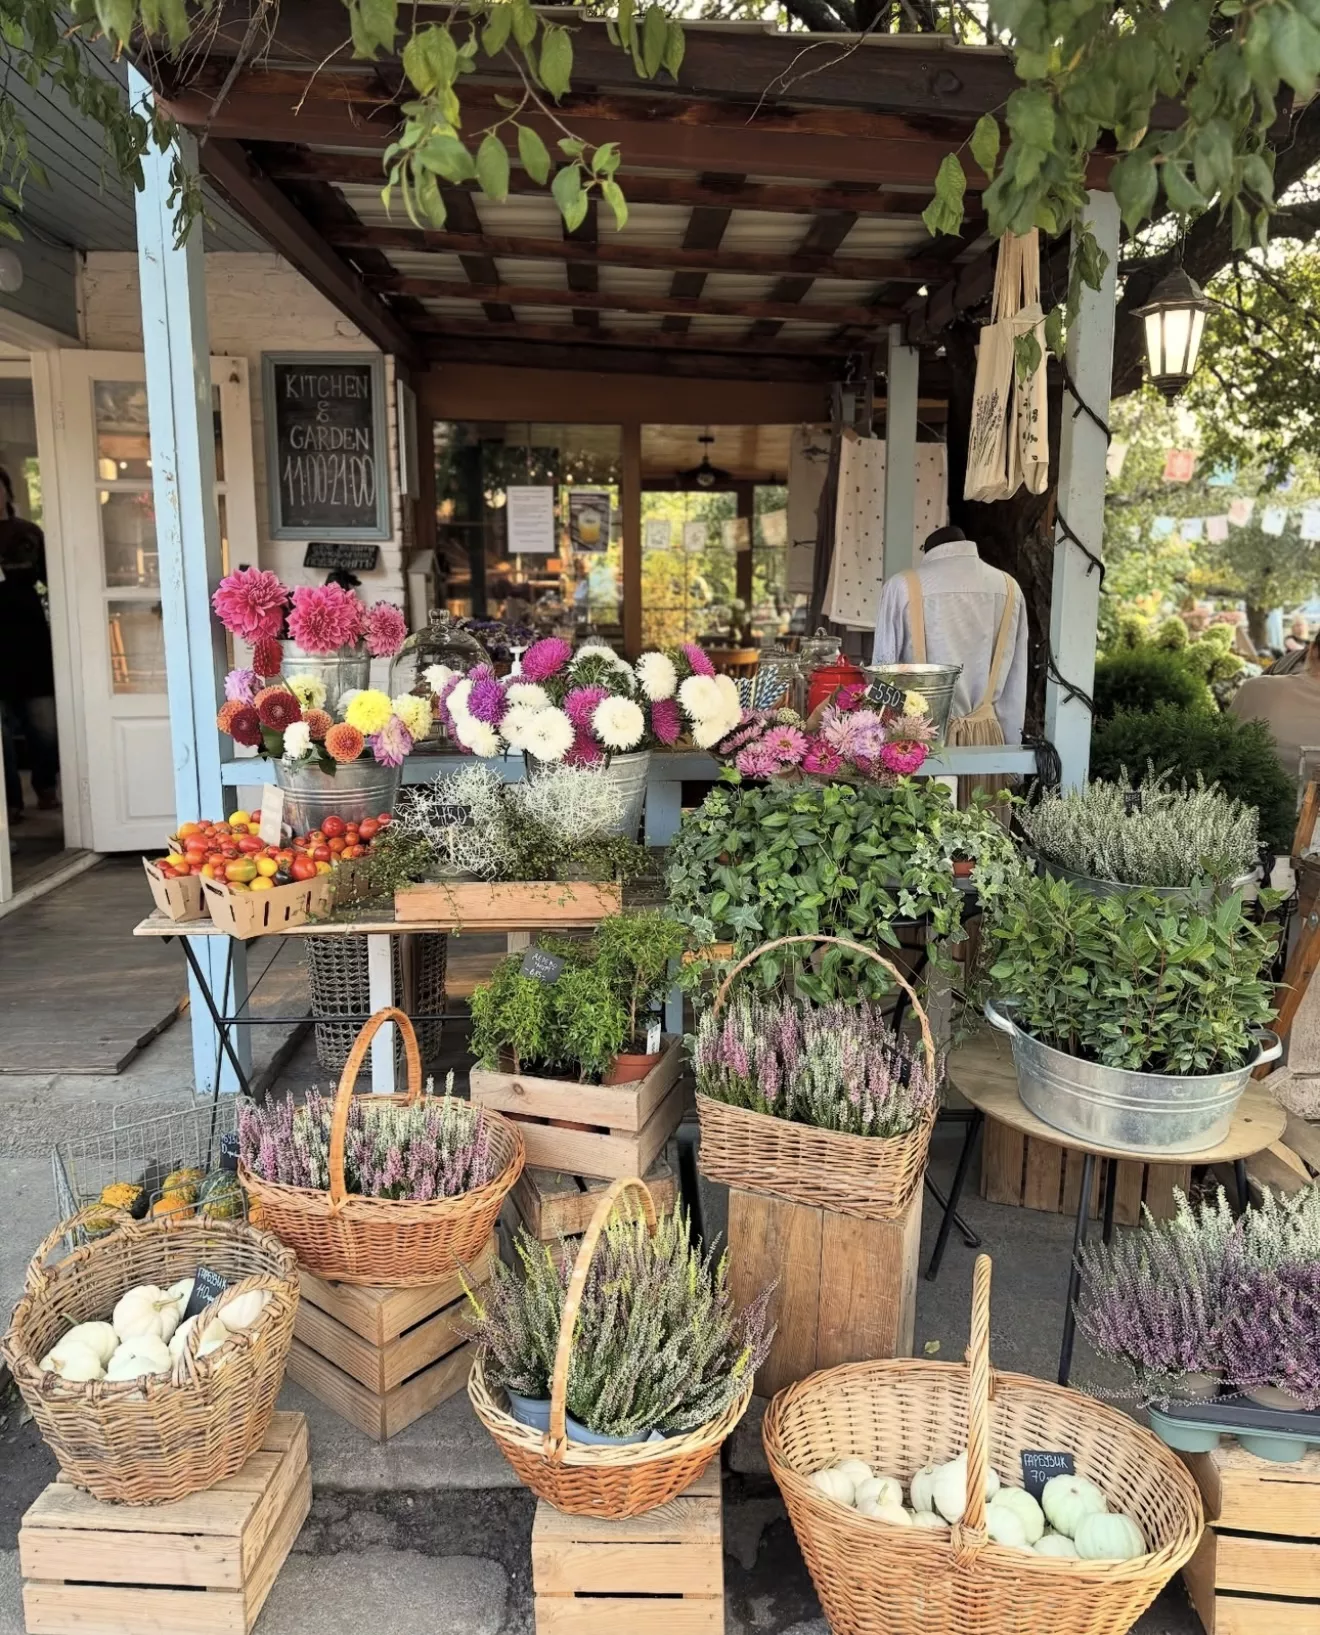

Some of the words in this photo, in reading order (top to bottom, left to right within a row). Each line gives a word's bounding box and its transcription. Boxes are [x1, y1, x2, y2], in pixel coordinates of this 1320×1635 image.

[286, 374, 368, 398] KITCHEN
[290, 426, 369, 450] GARDEN
[1023, 1453, 1068, 1469] ГАРБУЗИК
